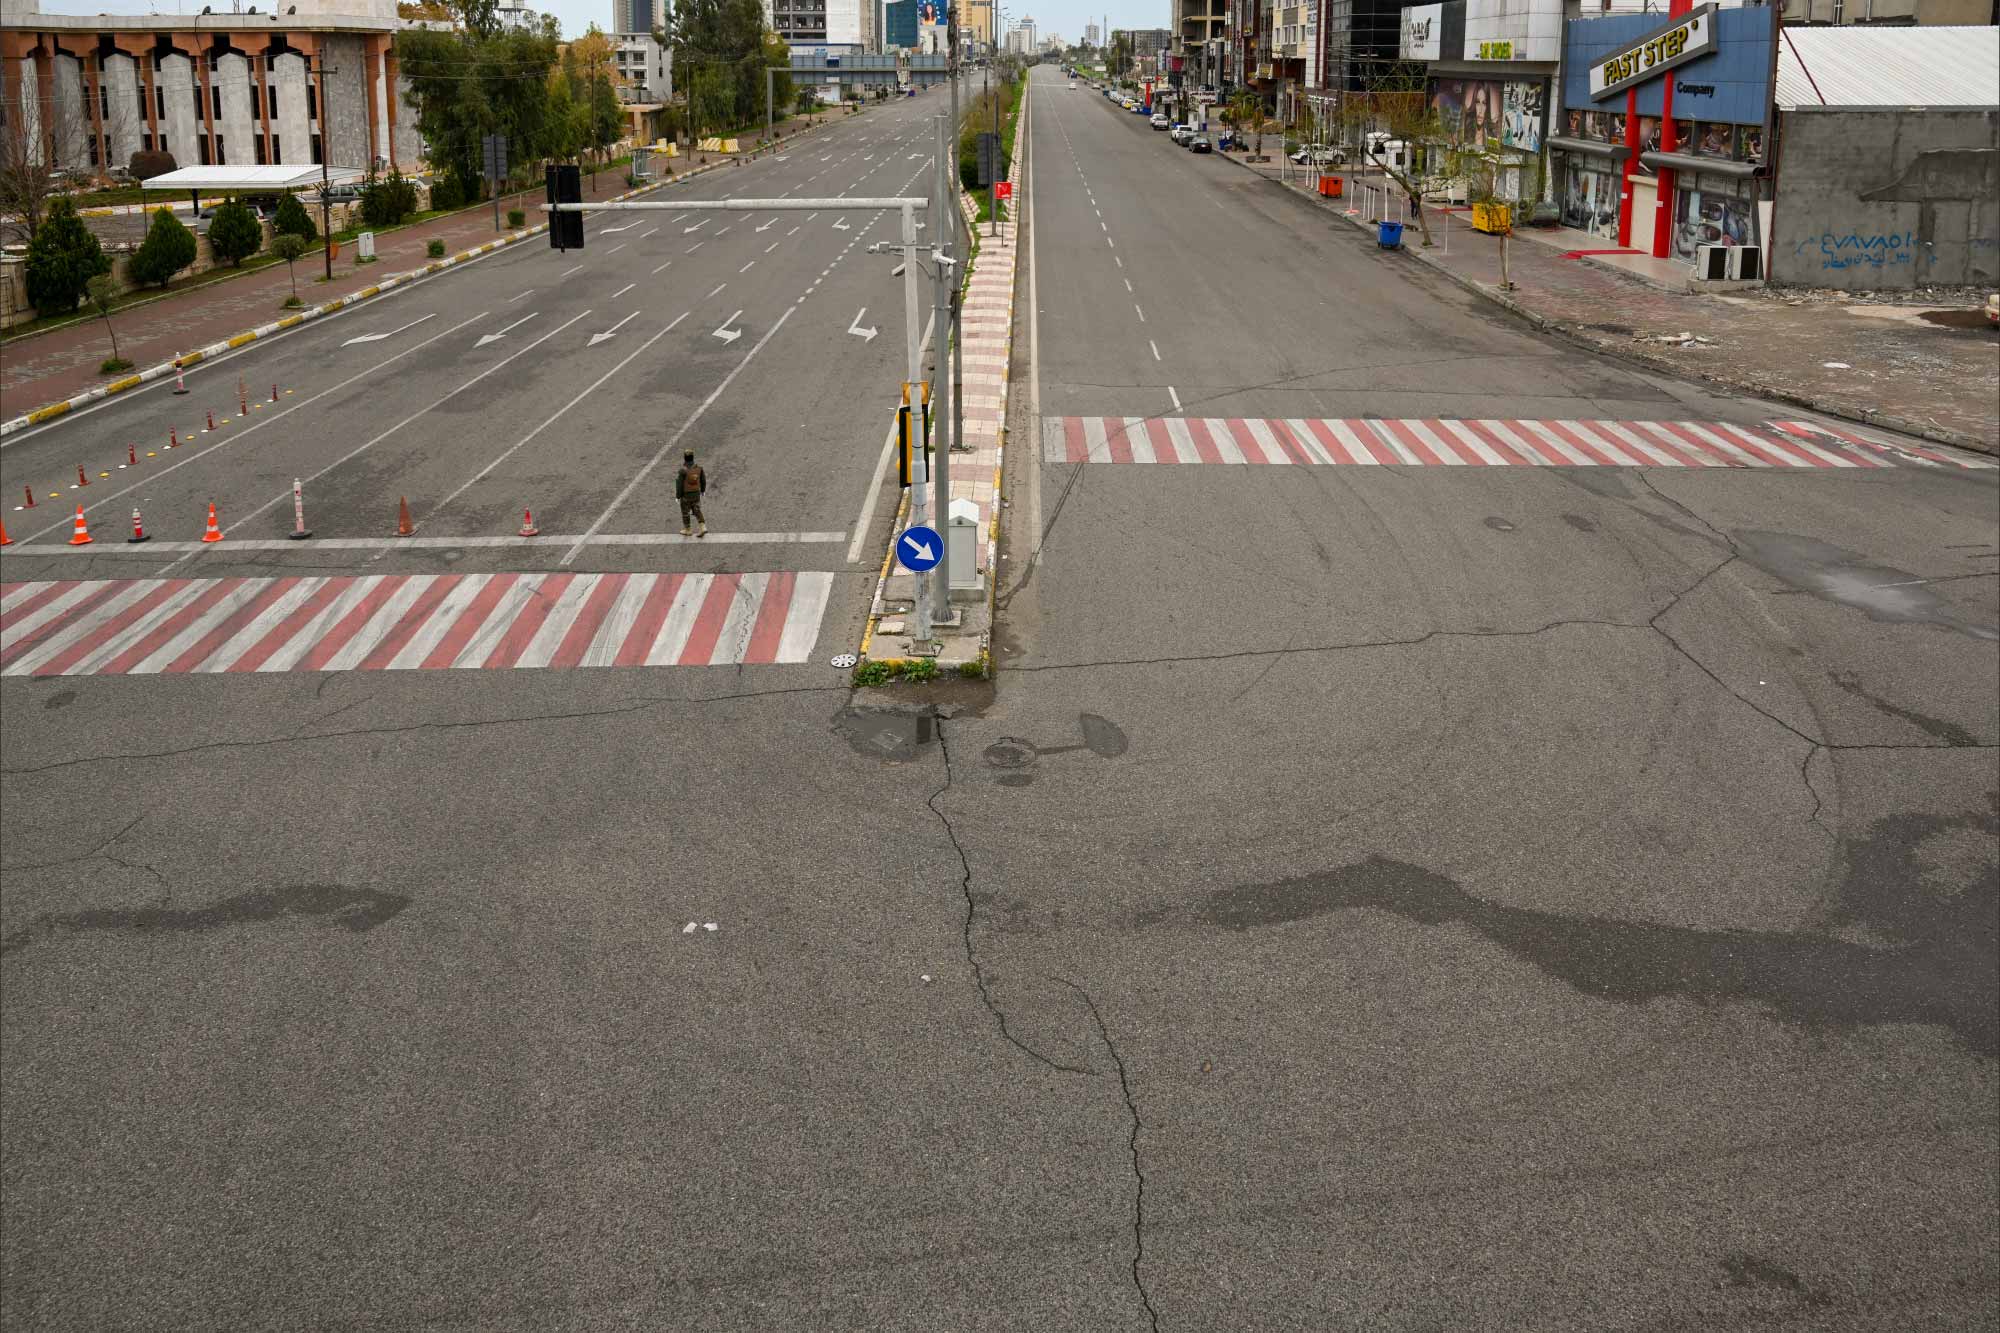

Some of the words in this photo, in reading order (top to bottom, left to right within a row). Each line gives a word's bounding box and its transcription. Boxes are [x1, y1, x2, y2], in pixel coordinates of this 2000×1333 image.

[1603, 48, 1642, 86] FAST
[1644, 26, 1688, 67] STEP
[1677, 82, 1715, 98] Company
